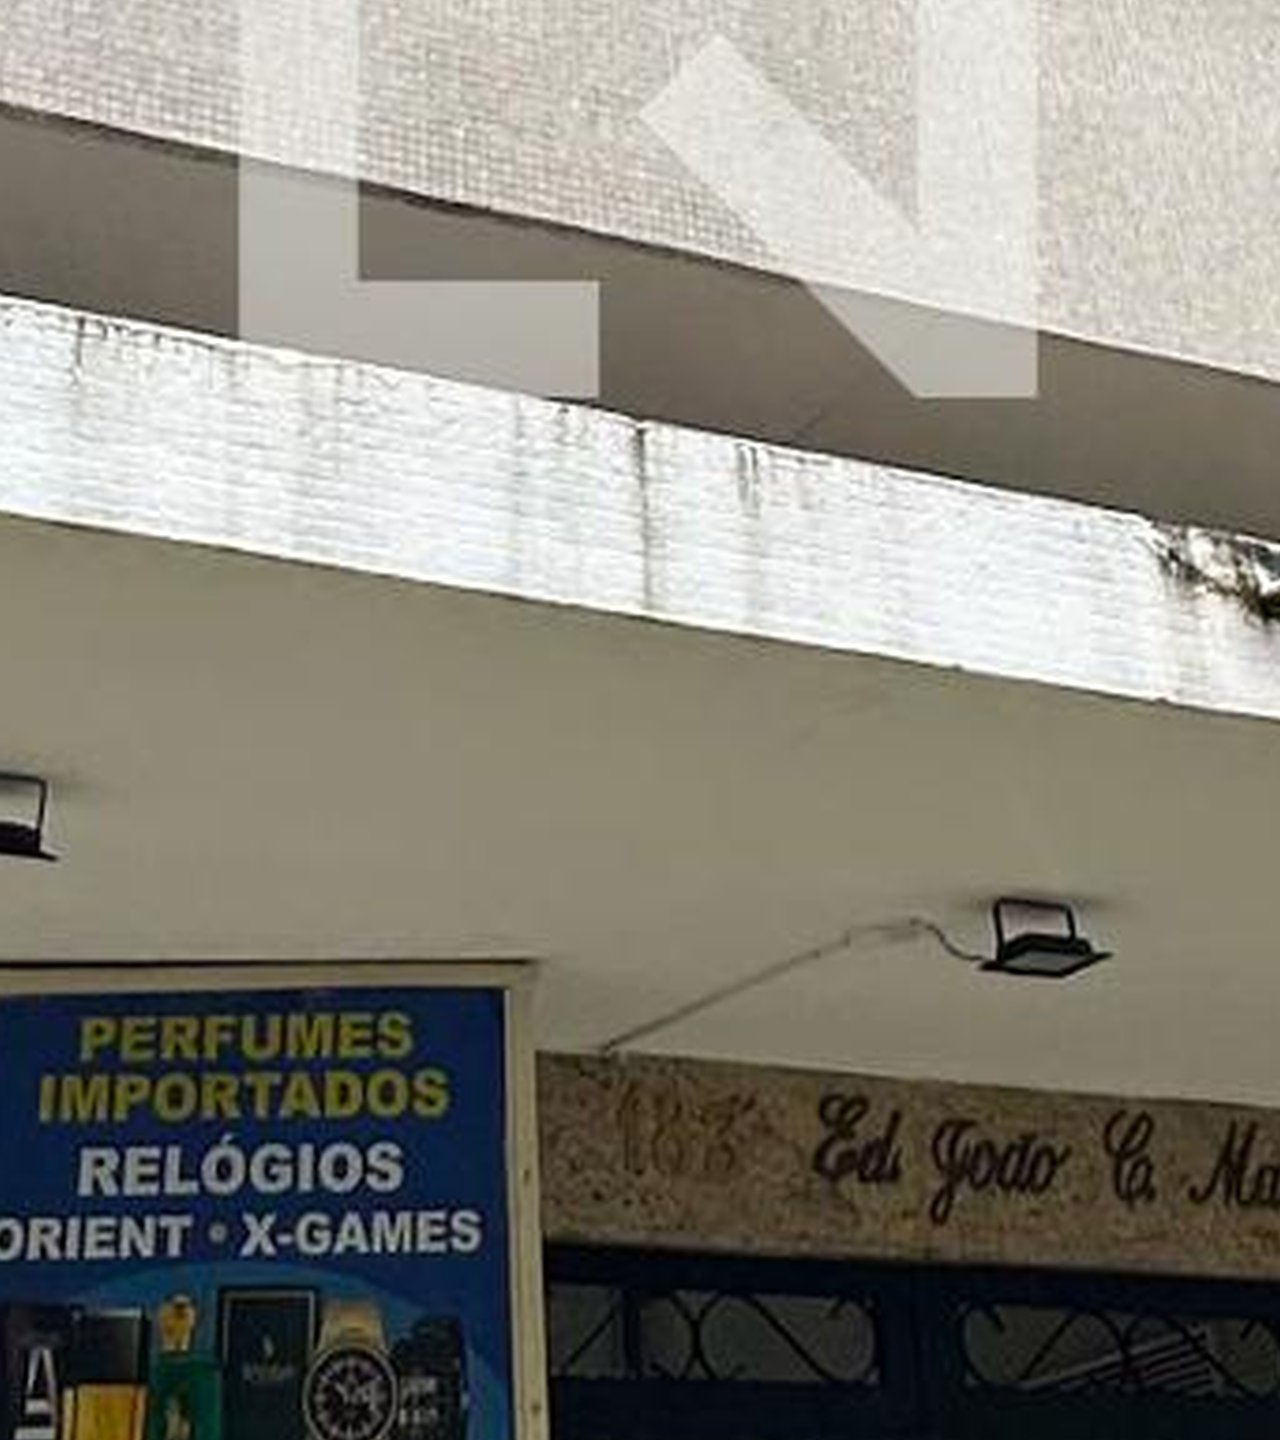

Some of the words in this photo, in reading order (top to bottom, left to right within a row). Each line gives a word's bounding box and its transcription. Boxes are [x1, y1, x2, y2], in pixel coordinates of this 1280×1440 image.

[81, 1012, 415, 1062] PERFUMES
[38, 1069, 451, 1123] IMPORTADOS
[76, 1133, 406, 1198] RELÓGIOS
[239, 1210, 485, 1258] X-GAMES
